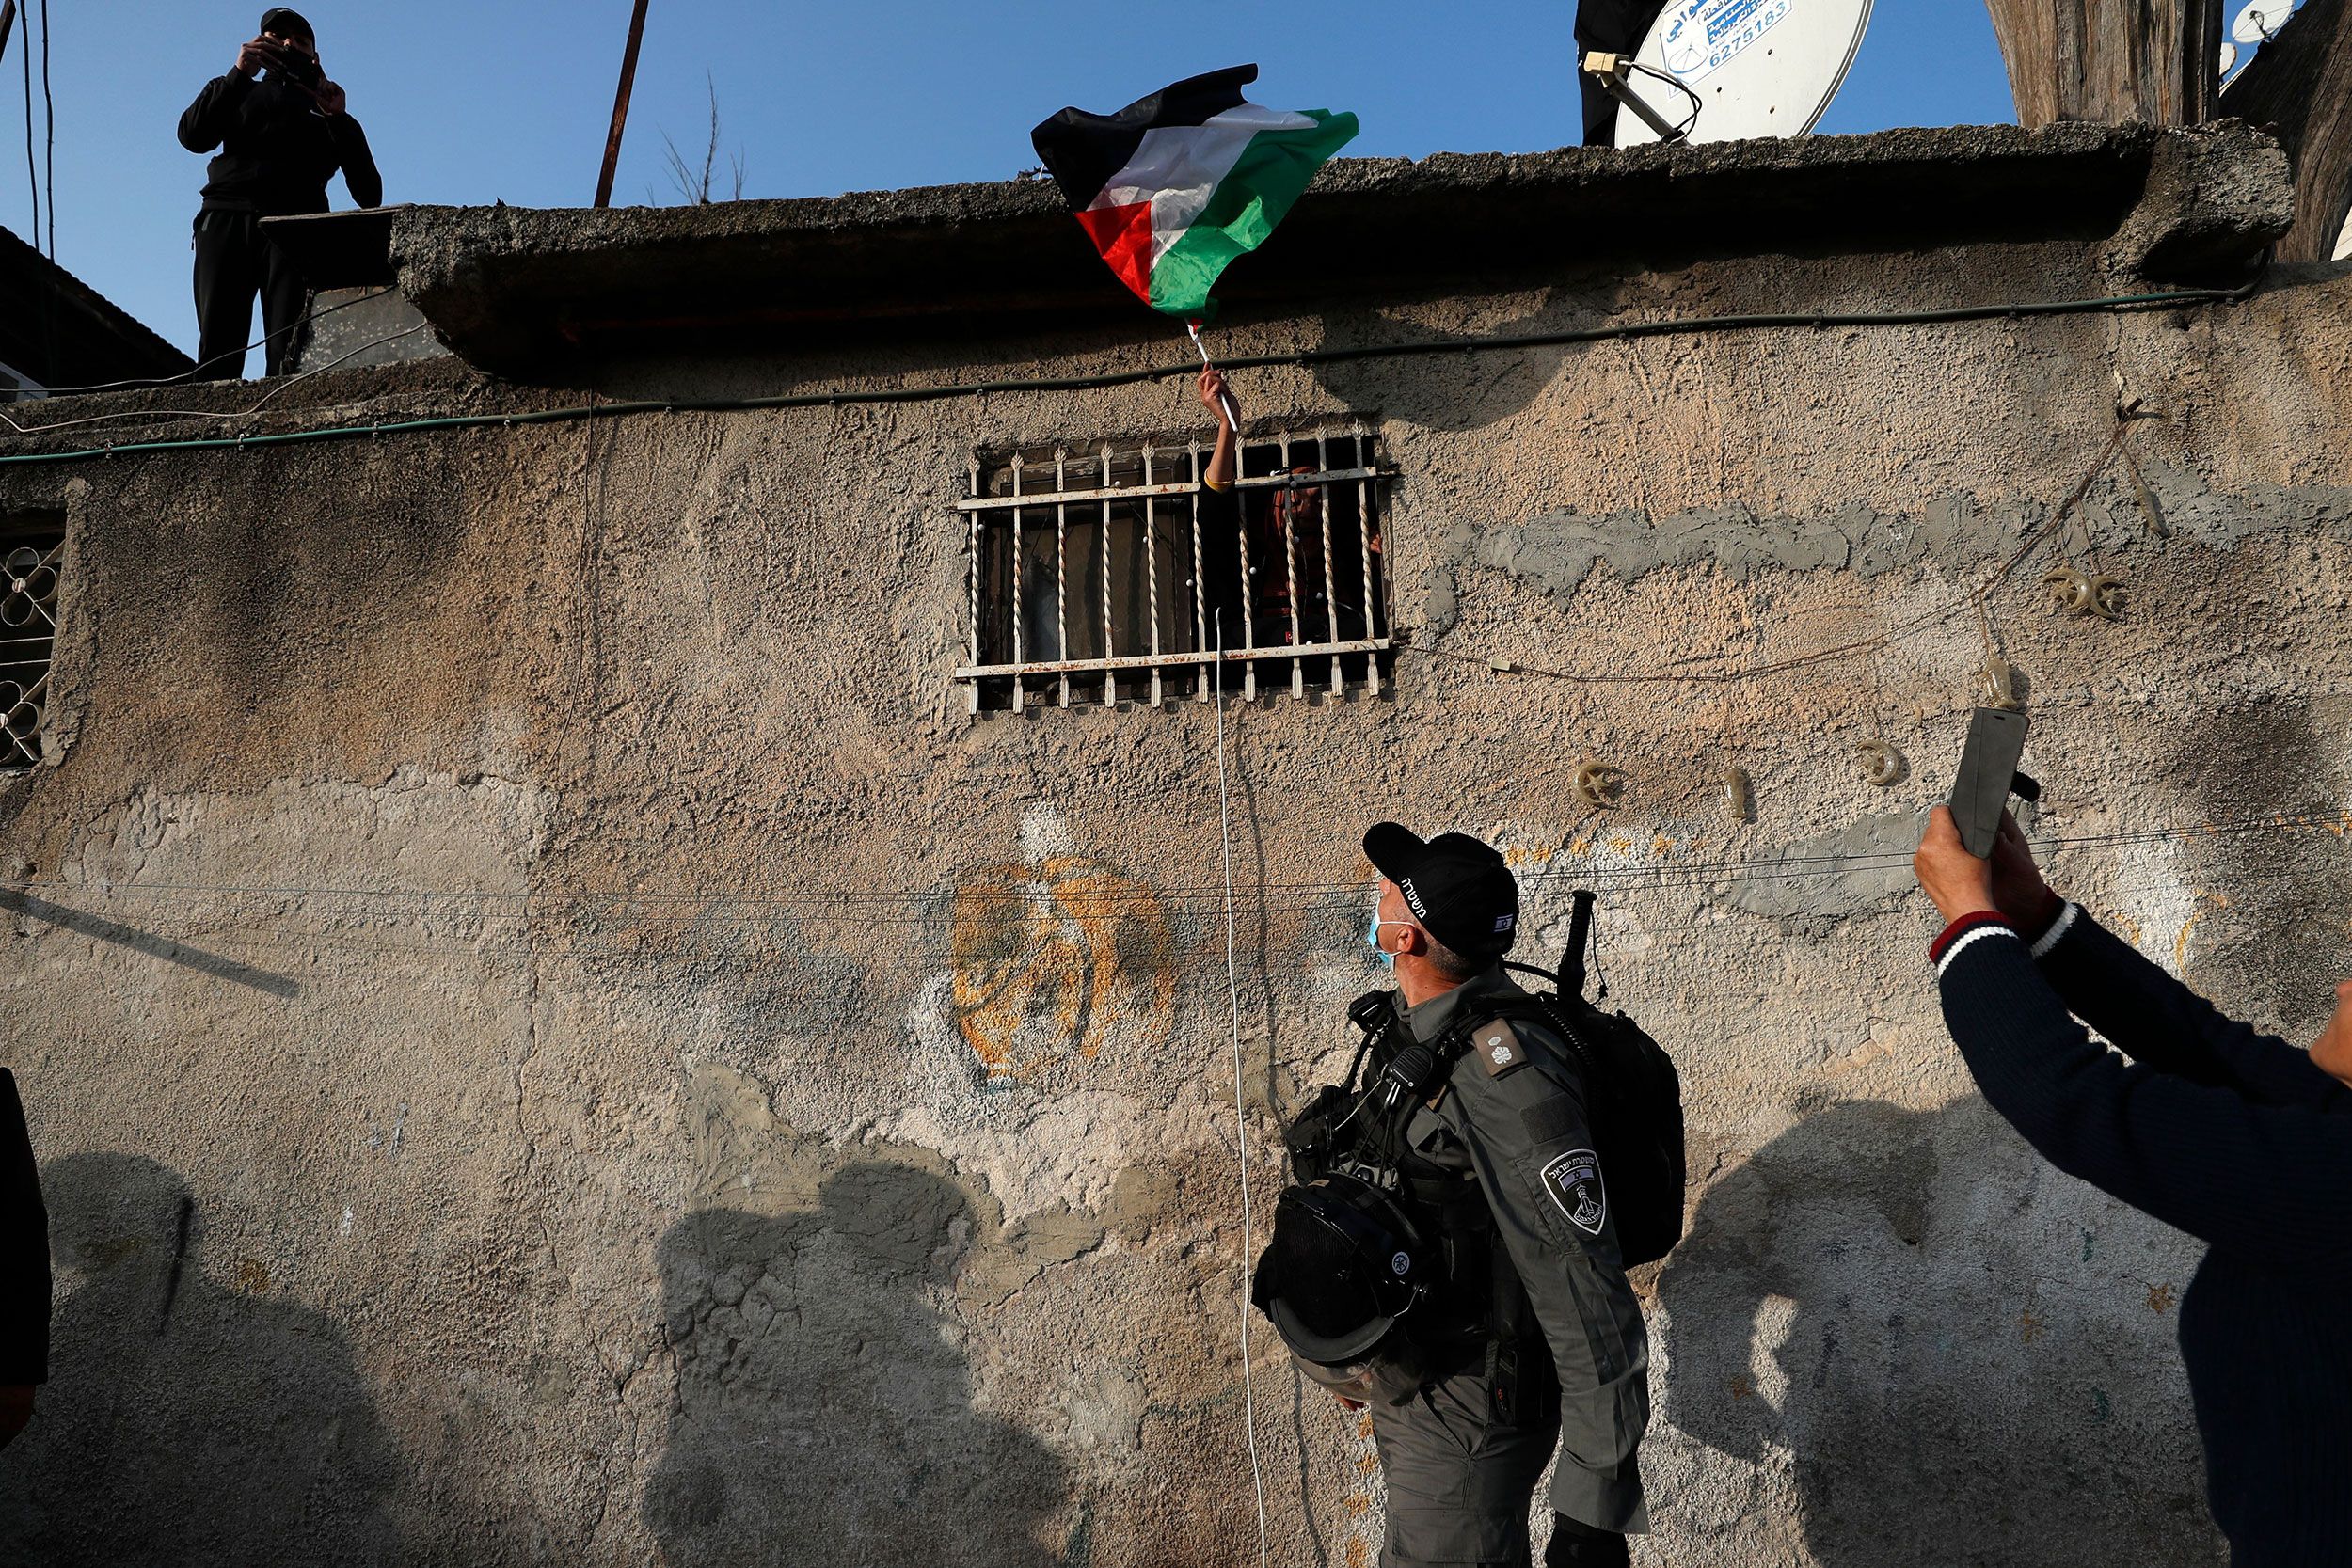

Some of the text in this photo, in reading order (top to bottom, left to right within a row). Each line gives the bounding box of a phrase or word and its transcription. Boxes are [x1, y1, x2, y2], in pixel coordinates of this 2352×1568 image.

[1709, 1, 1786, 67] 6275183
[1401, 877, 1427, 919] משטרה
[1548, 1160, 1572, 1180] ישראל
